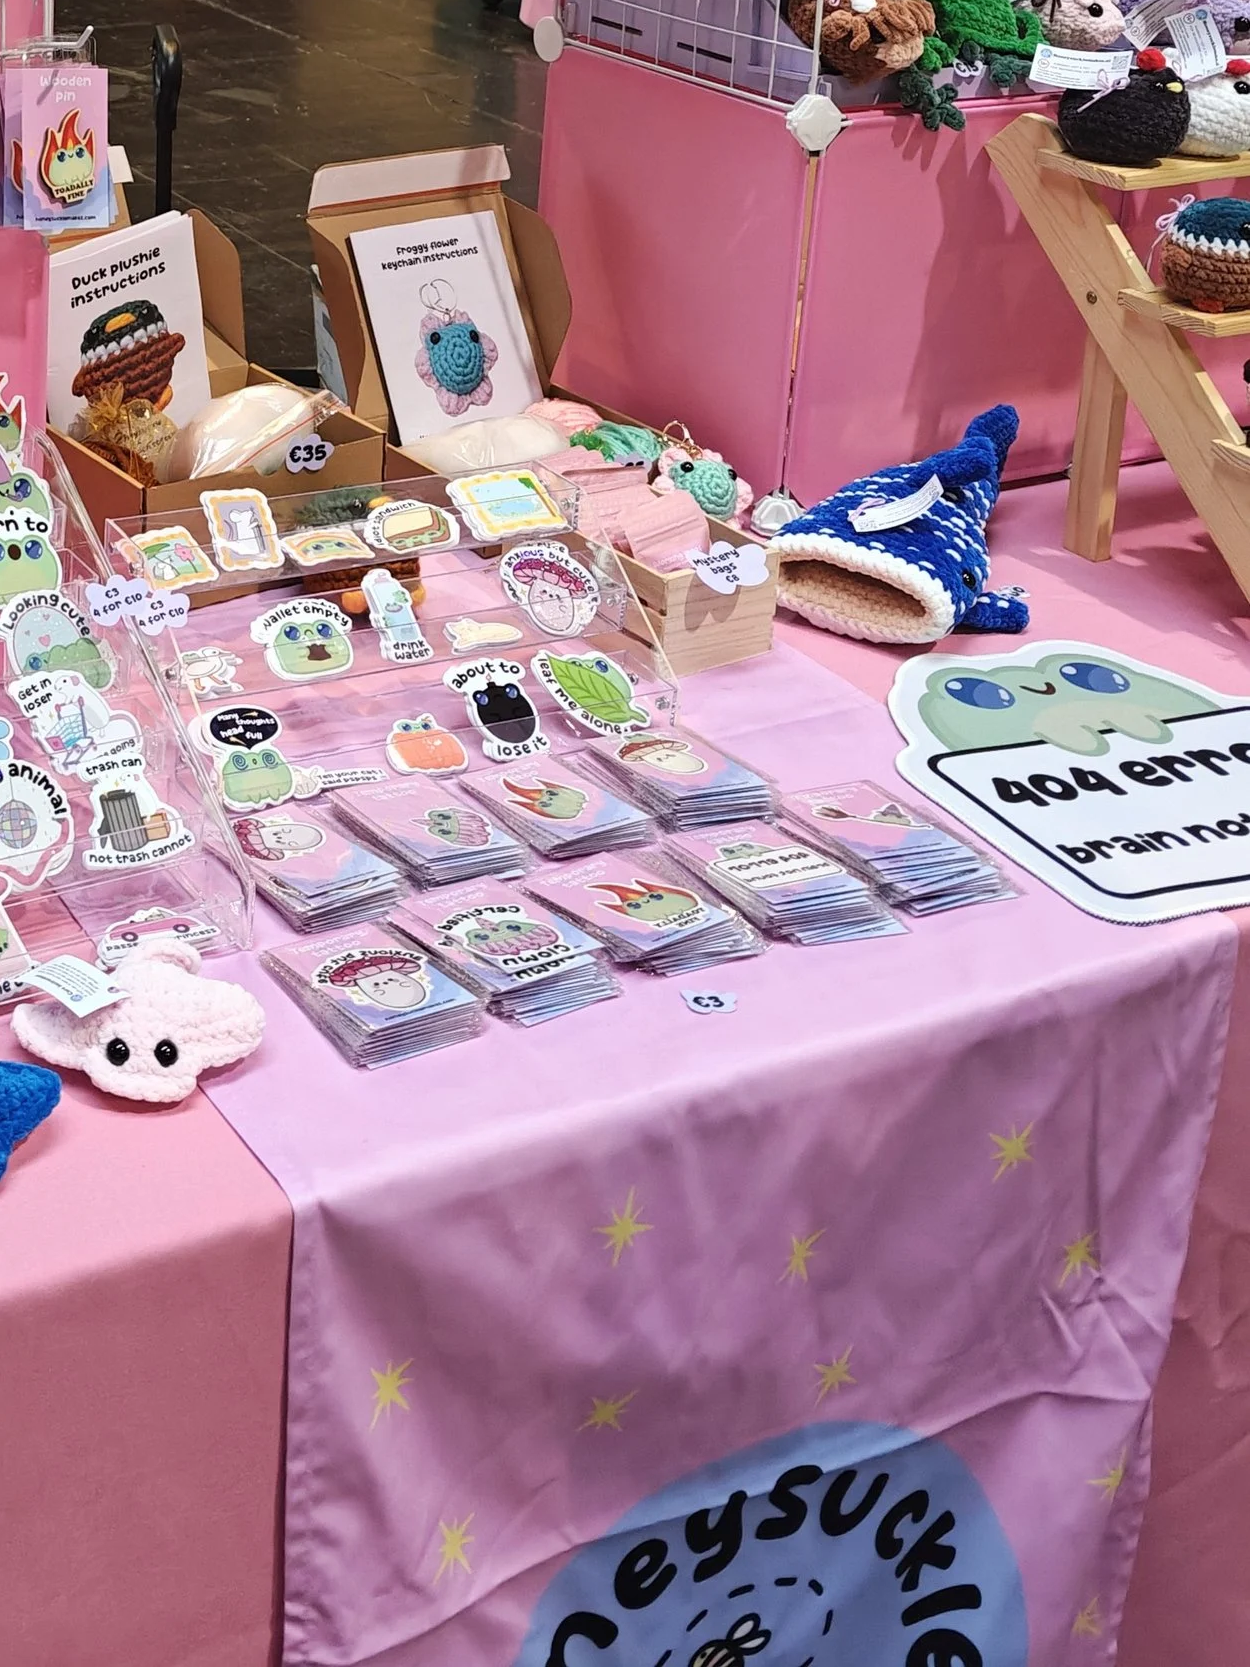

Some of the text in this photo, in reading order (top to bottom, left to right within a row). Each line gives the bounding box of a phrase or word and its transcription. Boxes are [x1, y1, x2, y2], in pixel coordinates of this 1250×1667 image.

[54, 179, 94, 196] TOADALLY
[67, 190, 85, 200] FINE
[396, 236, 459, 257] Froggy flower
[422, 245, 478, 265] instructions
[71, 246, 161, 291] Duck plushie
[70, 261, 166, 308] instructions
[289, 442, 328, 463] €35
[25, 520, 48, 534] to
[505, 549, 570, 568] anxious but
[693, 547, 740, 567] Mystery
[711, 561, 737, 575] bags
[105, 587, 120, 599] €3
[93, 593, 143, 618] 4 for €10
[150, 599, 164, 611] €3
[60, 601, 91, 637] cute
[148, 606, 185, 625] for €10
[303, 605, 349, 627] empty
[393, 640, 425, 650] drink
[394, 648, 430, 660] water
[452, 661, 520, 689] about to
[538, 658, 578, 711] leaf me
[18, 678, 51, 701] Get in
[23, 692, 52, 713] loser
[217, 713, 239, 721] Many
[236, 718, 275, 726] thoughts
[220, 726, 244, 738] head
[245, 732, 262, 740] full
[497, 736, 547, 757] lose it
[86, 756, 142, 775] trash can
[8, 762, 67, 815] animal
[992, 766, 1129, 807] 404
[89, 834, 192, 864] not trash cannot
[1056, 826, 1191, 864] brain
